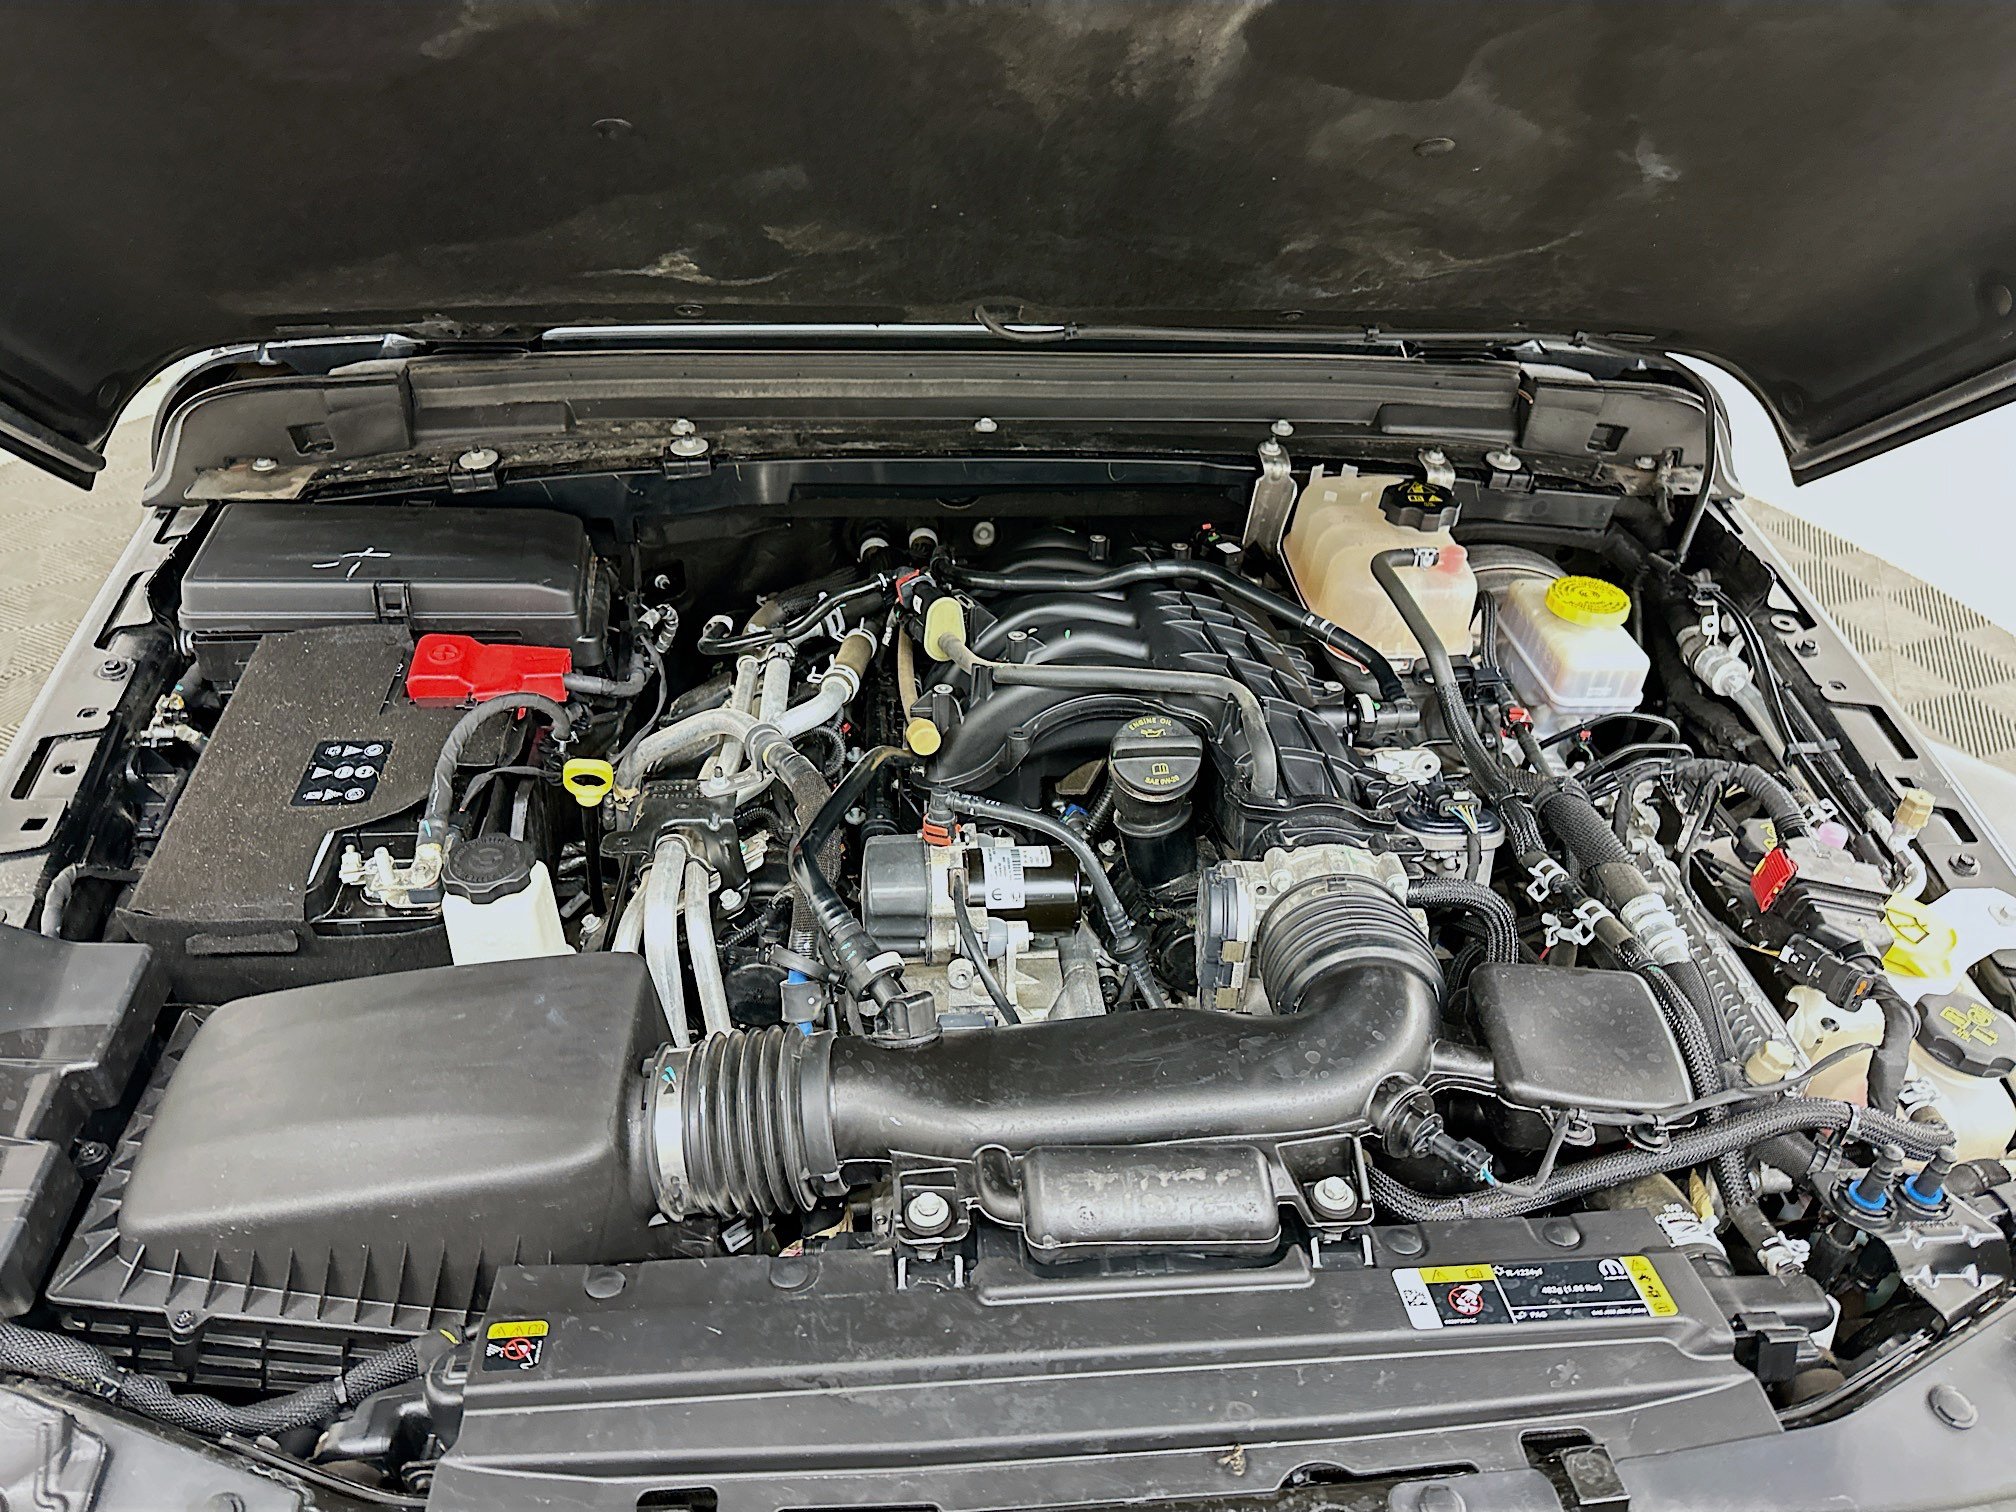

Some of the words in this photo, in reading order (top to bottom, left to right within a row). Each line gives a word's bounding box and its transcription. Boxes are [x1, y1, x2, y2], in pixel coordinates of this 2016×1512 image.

[1128, 717, 1157, 731] ENGINE
[1160, 717, 1172, 726] OIL
[1144, 776, 1159, 785] SAE
